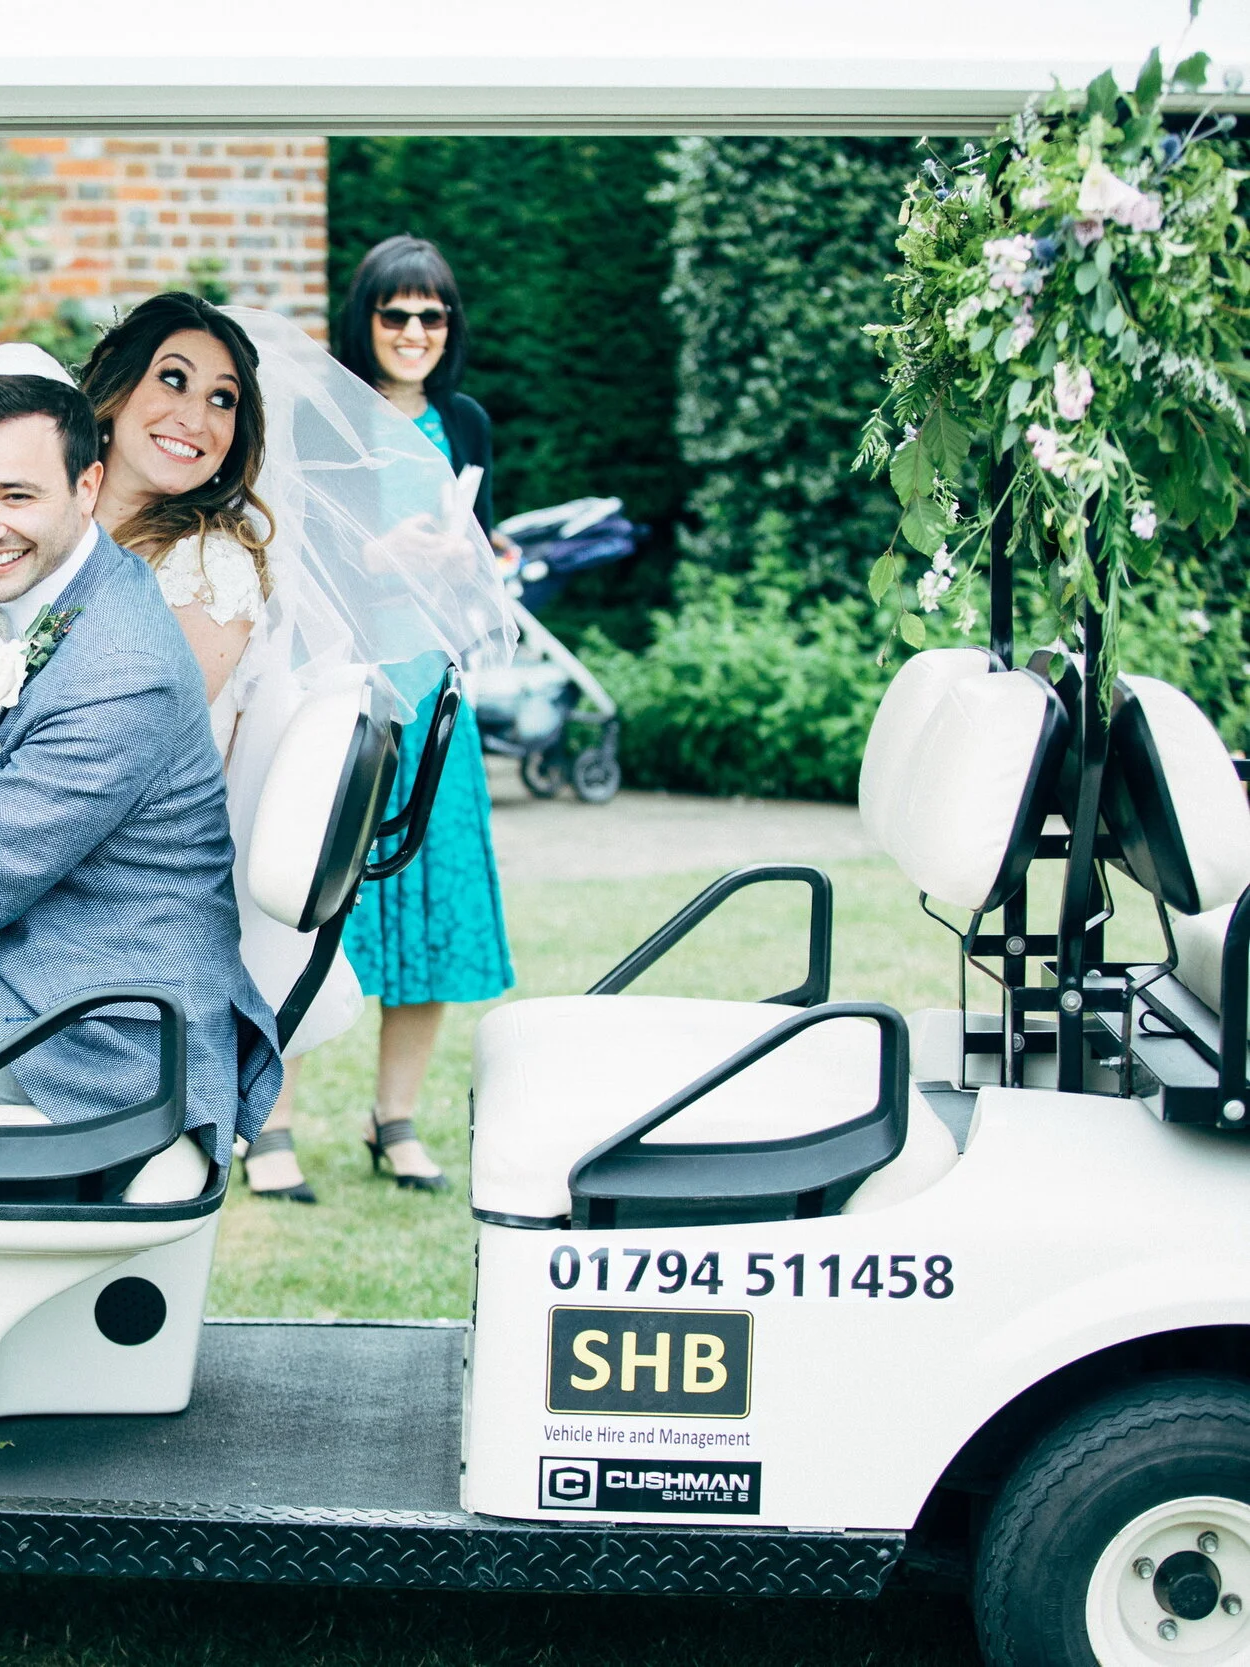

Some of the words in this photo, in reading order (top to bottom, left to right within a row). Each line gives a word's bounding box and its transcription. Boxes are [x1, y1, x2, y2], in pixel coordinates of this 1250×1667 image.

[549, 1245, 724, 1295] 01794
[746, 1253, 955, 1299] 511458
[570, 1329, 728, 1394] SHB
[544, 1425, 593, 1442] Vehicle
[597, 1427, 625, 1443] Hire
[629, 1428, 655, 1444] and
[659, 1429, 751, 1449] Management
[605, 1470, 750, 1491] CUSHMAN
[662, 1490, 733, 1502] SHUTTLE
[737, 1491, 749, 1502] 6
